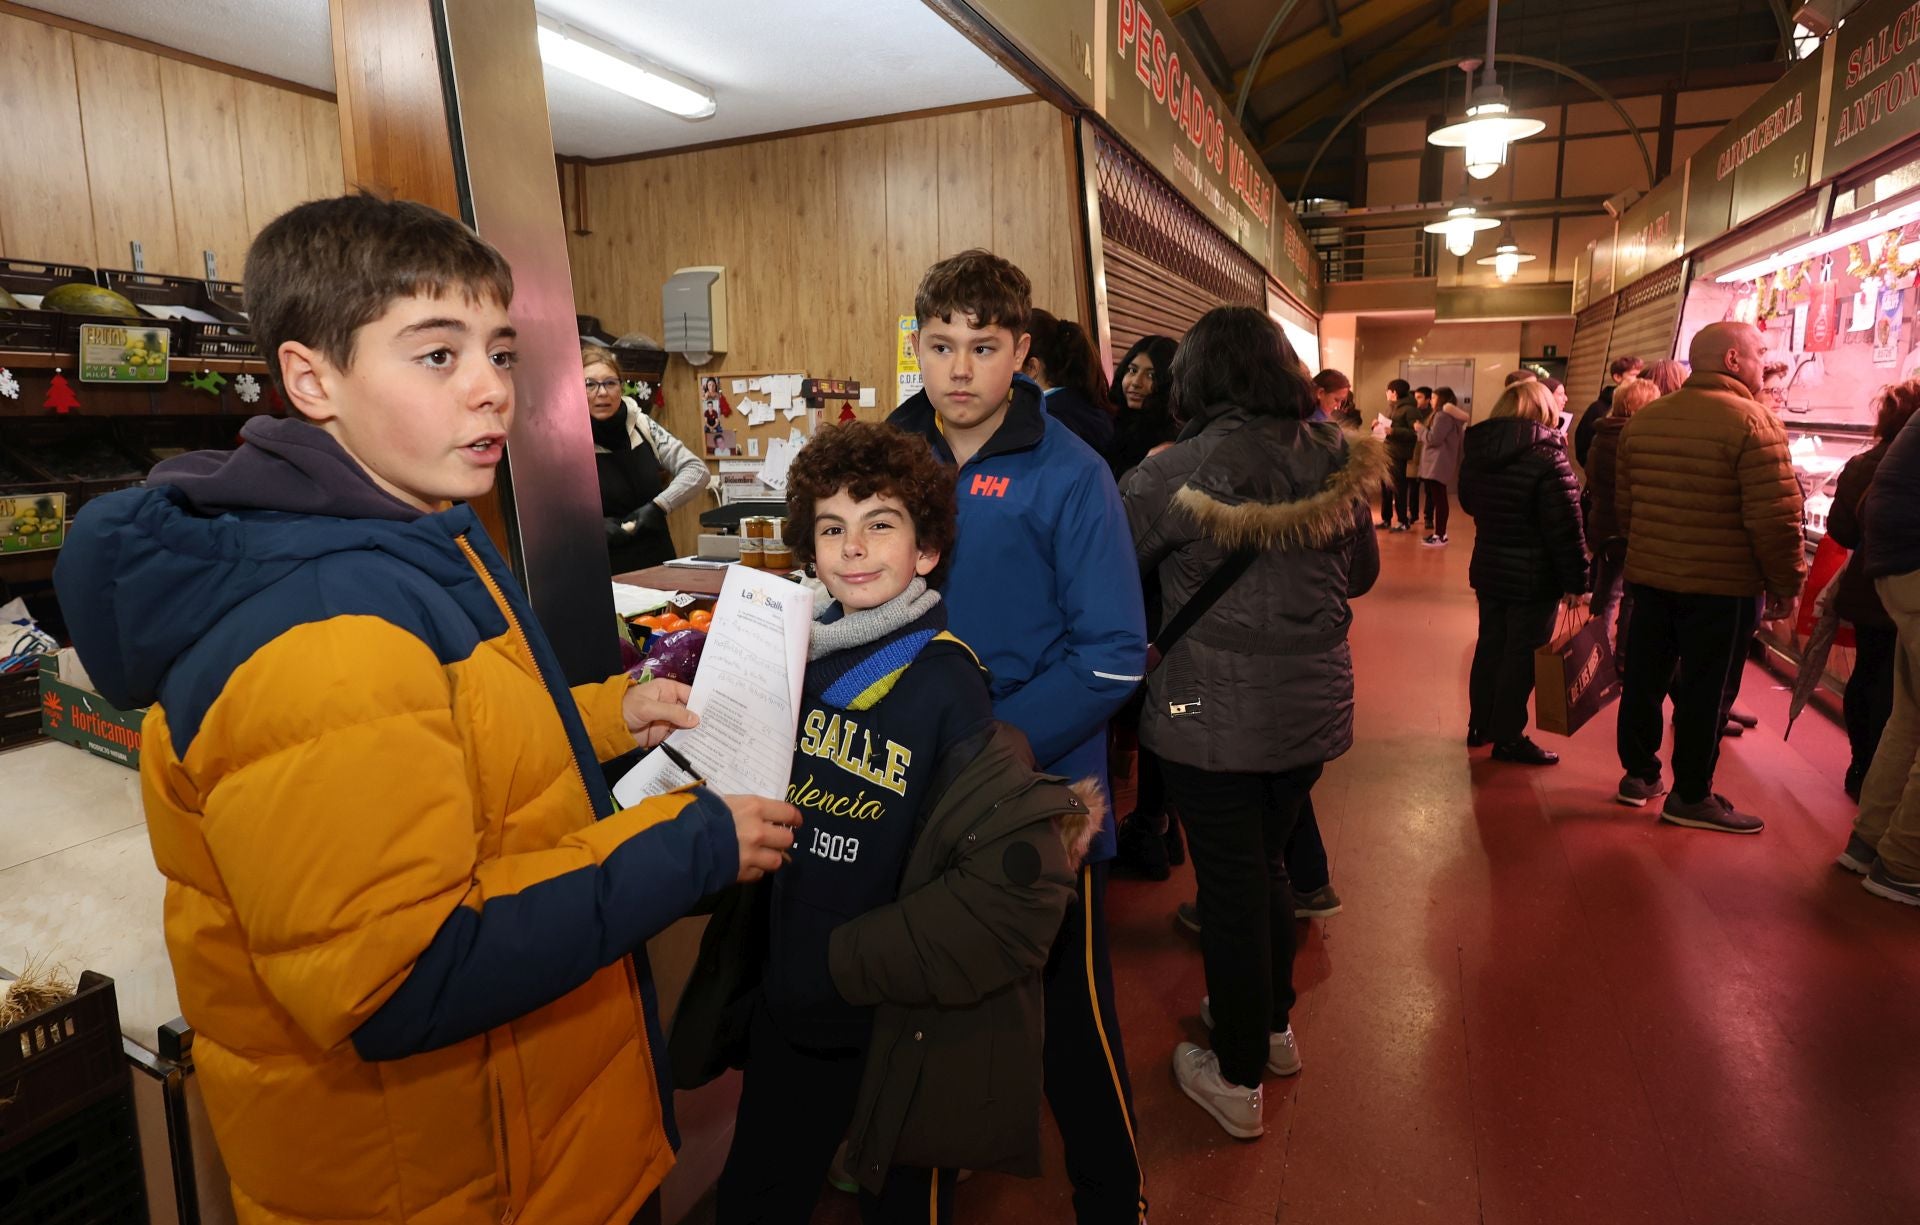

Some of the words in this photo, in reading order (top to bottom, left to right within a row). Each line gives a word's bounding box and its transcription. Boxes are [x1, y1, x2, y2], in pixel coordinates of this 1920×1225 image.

[1118, 0, 1224, 175] PESCADOS
[1229, 136, 1270, 229] VALLEJO
[1716, 92, 1803, 182] CARNICERIA
[86, 326, 128, 346] FRUTAS
[970, 473, 1010, 498] HH
[741, 588, 753, 600] La
[800, 708, 913, 798] SALLE
[785, 773, 886, 821] alencia
[809, 827, 860, 863] 1903
